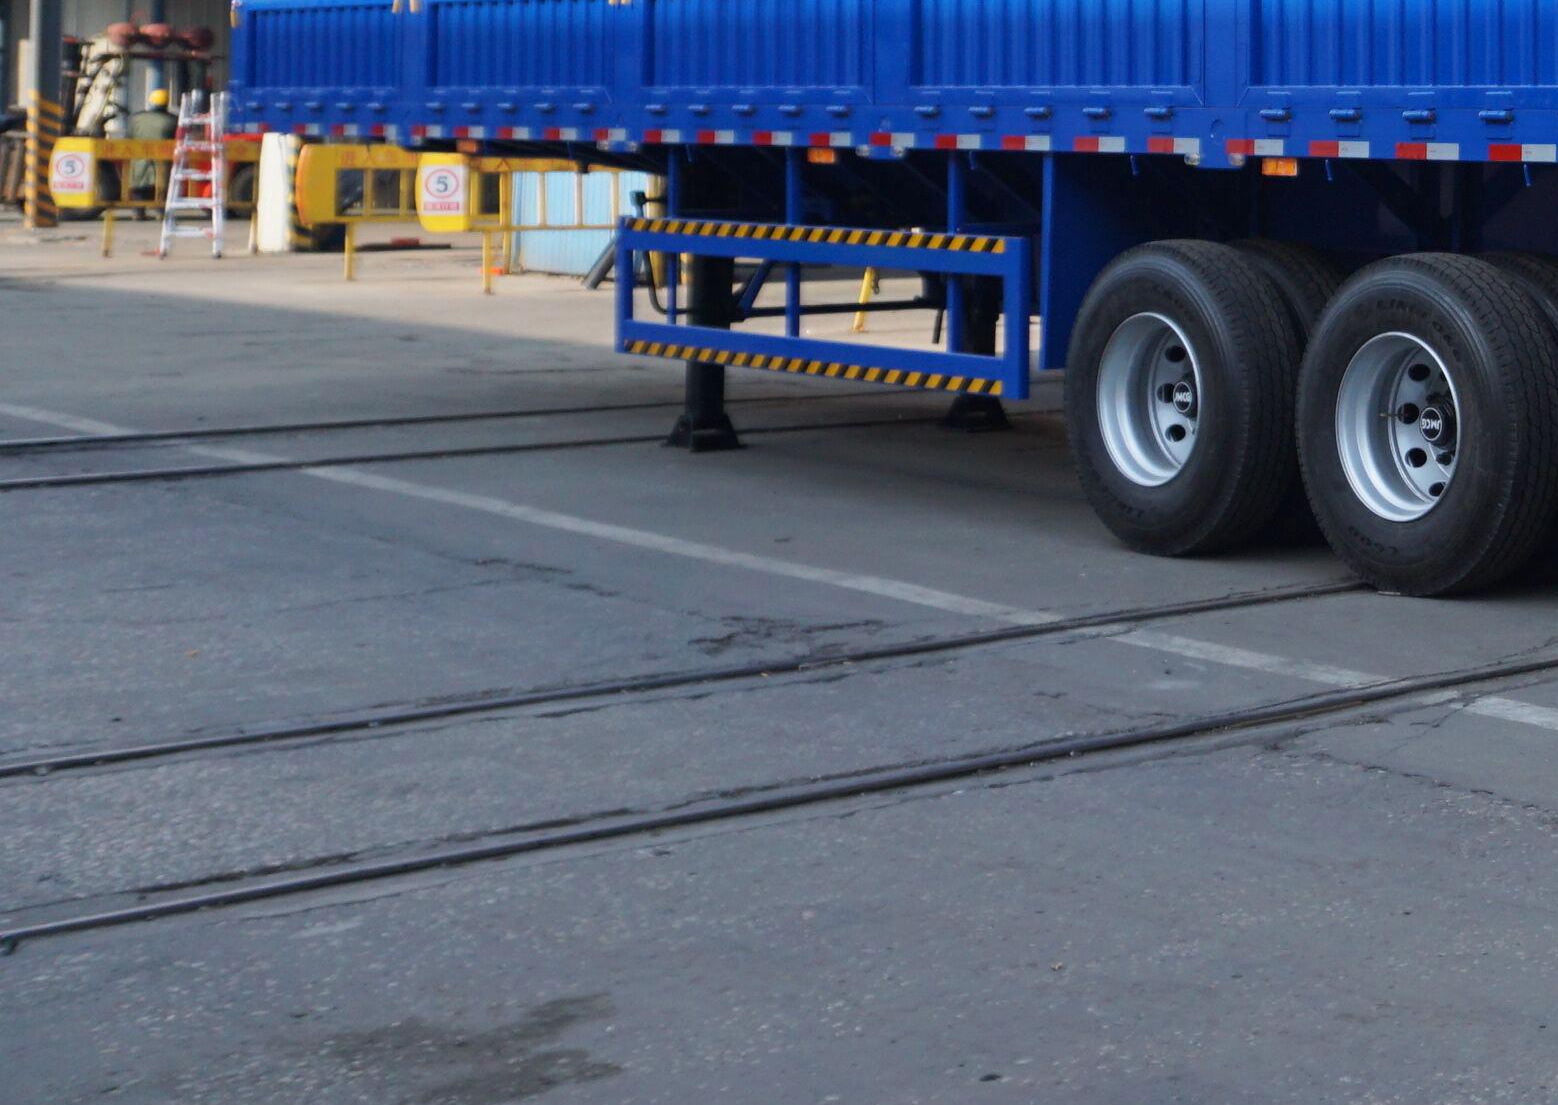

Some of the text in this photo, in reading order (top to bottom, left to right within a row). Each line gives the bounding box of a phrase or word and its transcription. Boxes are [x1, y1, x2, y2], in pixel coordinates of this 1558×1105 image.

[64, 160, 76, 175] 5
[436, 175, 448, 192] 5
[1421, 418, 1440, 430] JMCG
